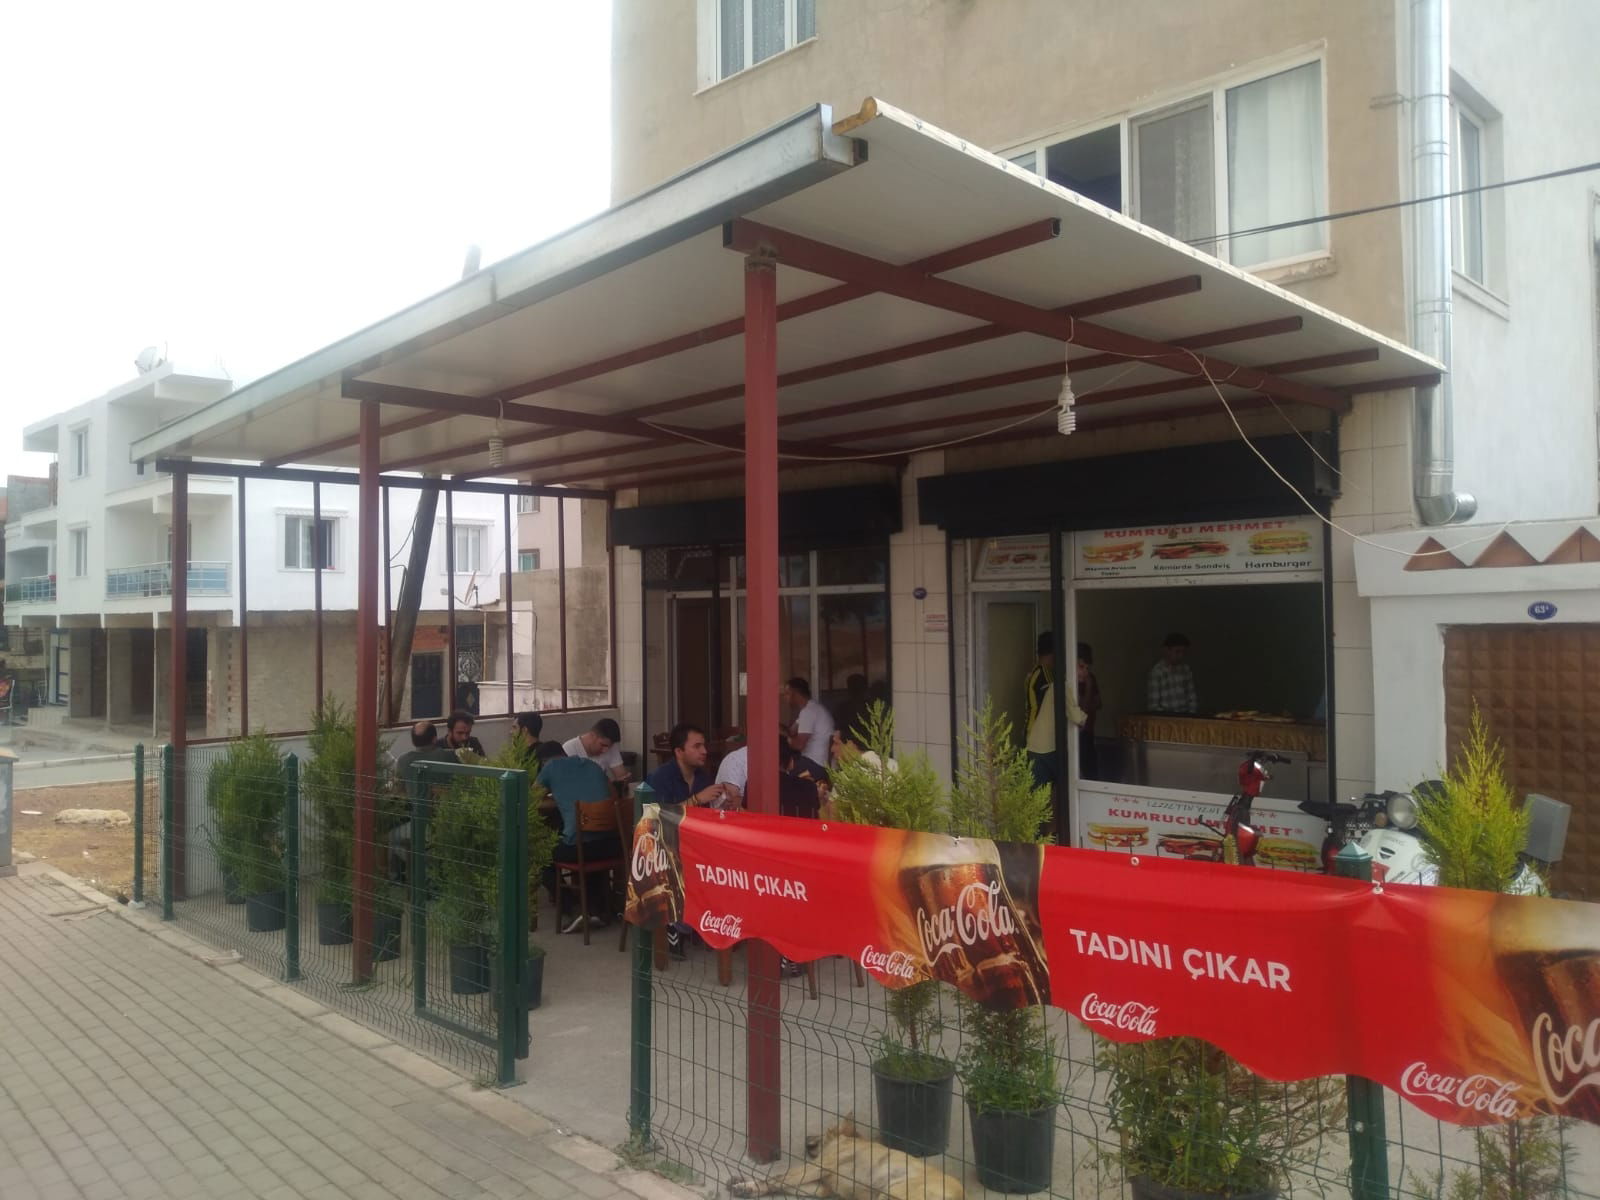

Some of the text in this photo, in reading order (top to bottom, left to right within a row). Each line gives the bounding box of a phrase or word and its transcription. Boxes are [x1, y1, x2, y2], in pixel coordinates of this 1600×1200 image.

[1103, 520, 1286, 539] KUMRUCU MEHMET
[1244, 559, 1312, 570] Hamburger
[1108, 808, 1200, 827] KUMRUCU
[695, 863, 808, 902] TADINI ÇIKAR
[1069, 928, 1292, 992] TADINI ÇIKAR
